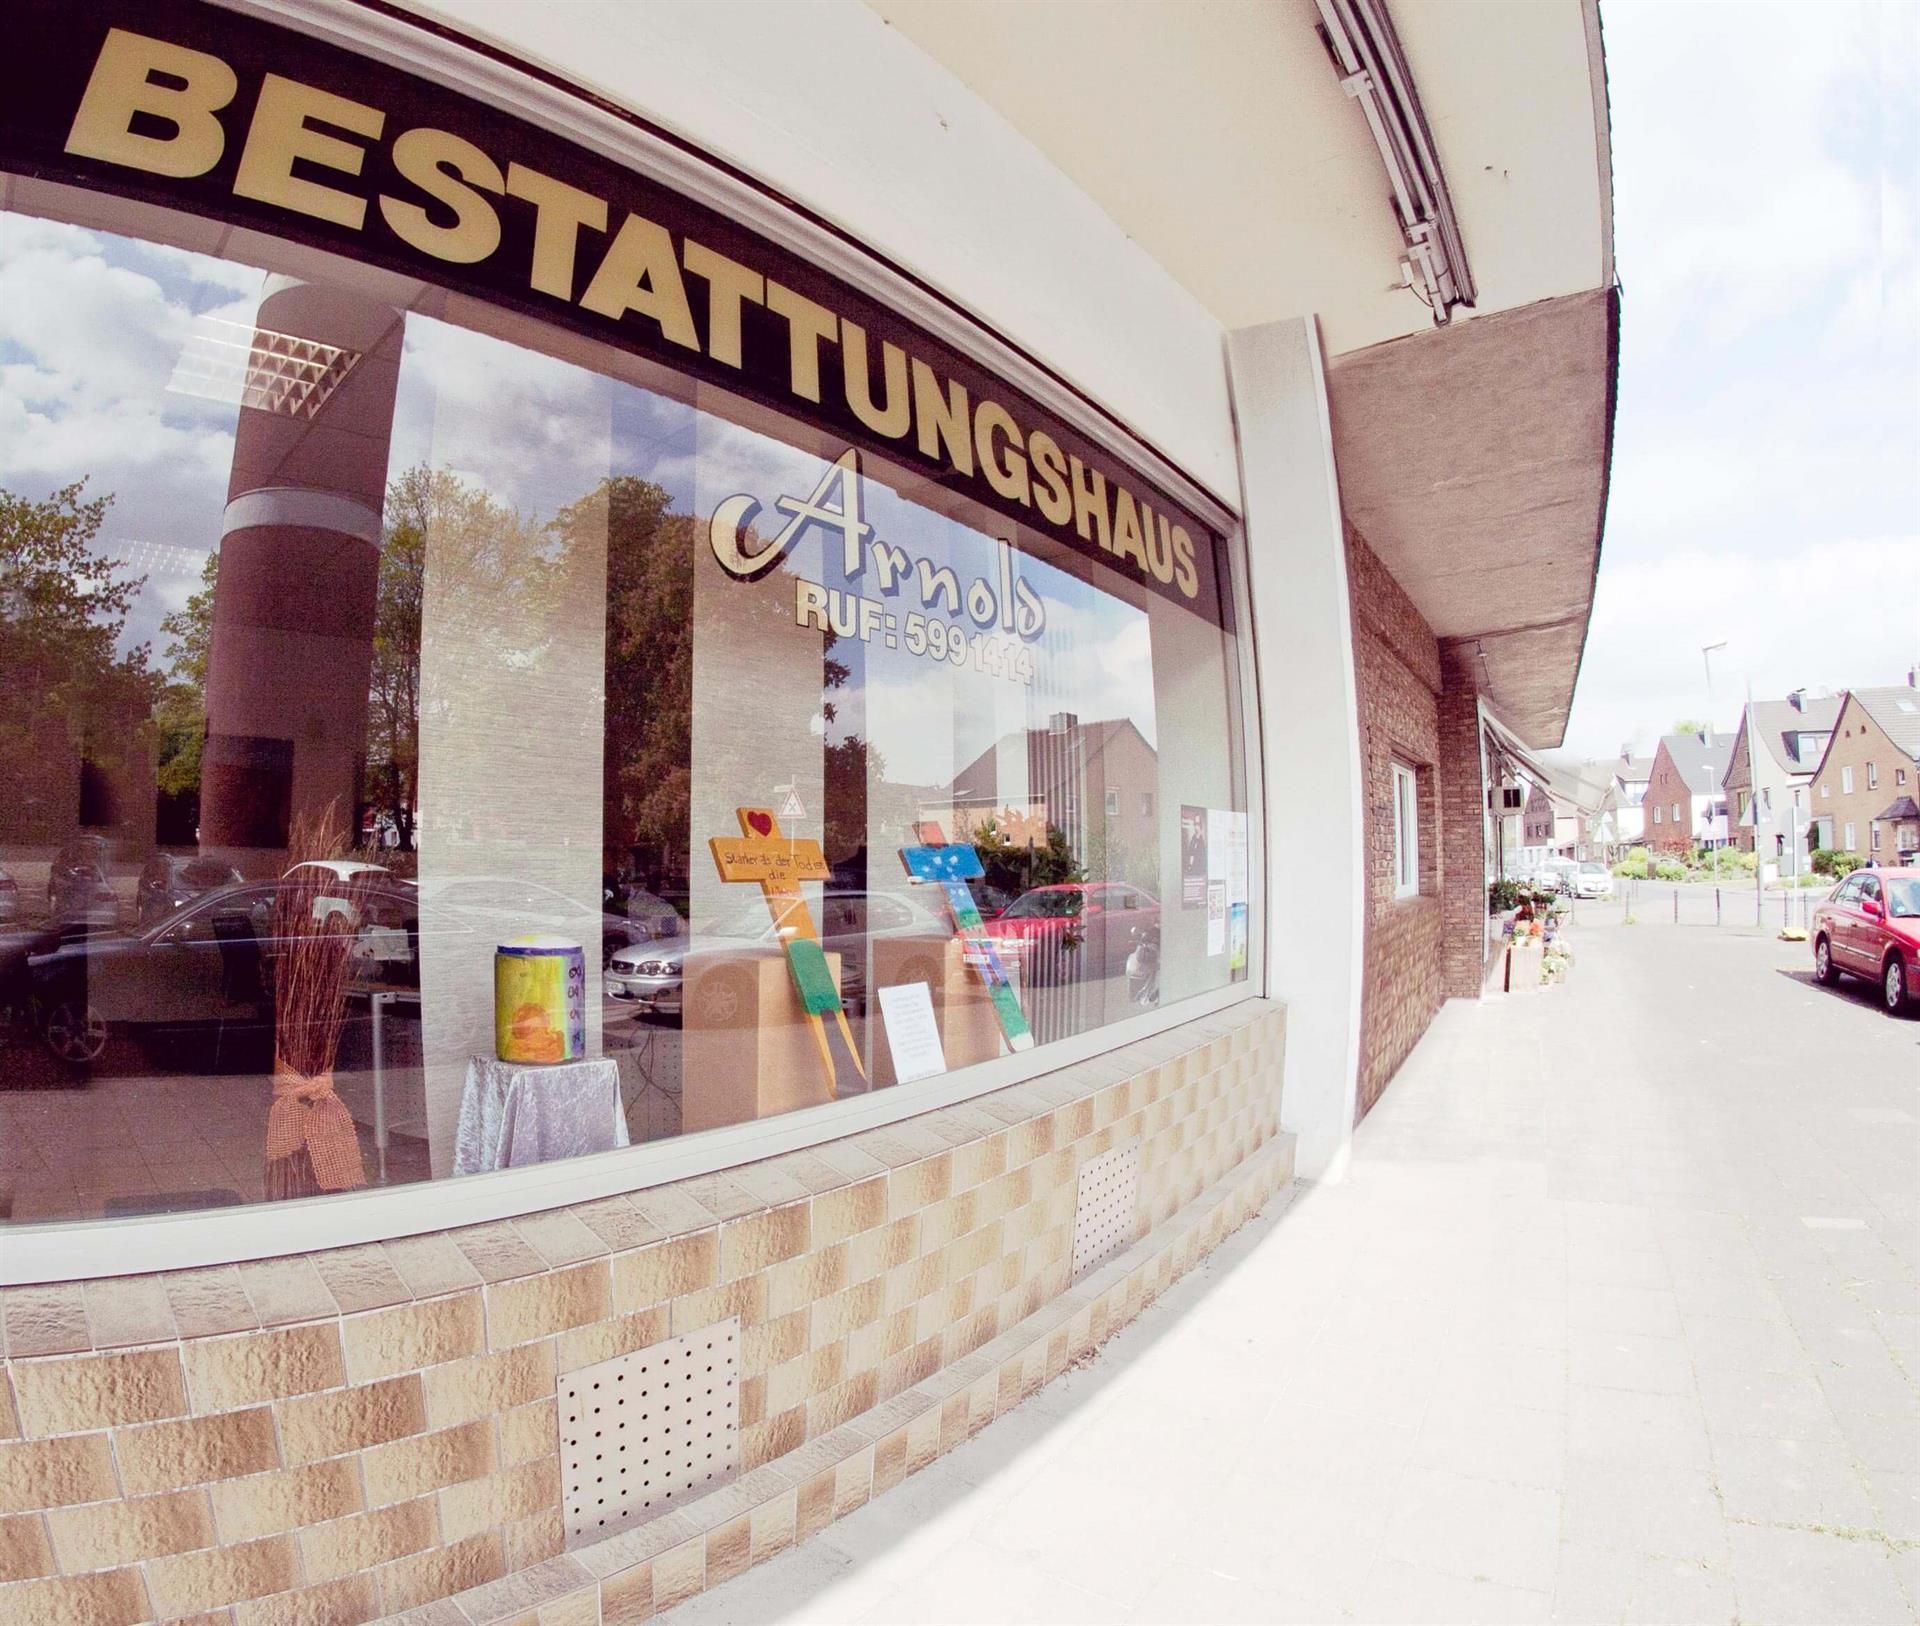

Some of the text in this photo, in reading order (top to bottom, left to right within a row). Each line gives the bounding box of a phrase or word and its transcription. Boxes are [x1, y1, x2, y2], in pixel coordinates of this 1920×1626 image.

[63, 26, 1201, 599] BESTATTUNGSHAUS
[709, 446, 1046, 643] Arnold
[795, 577, 898, 650] RUF:
